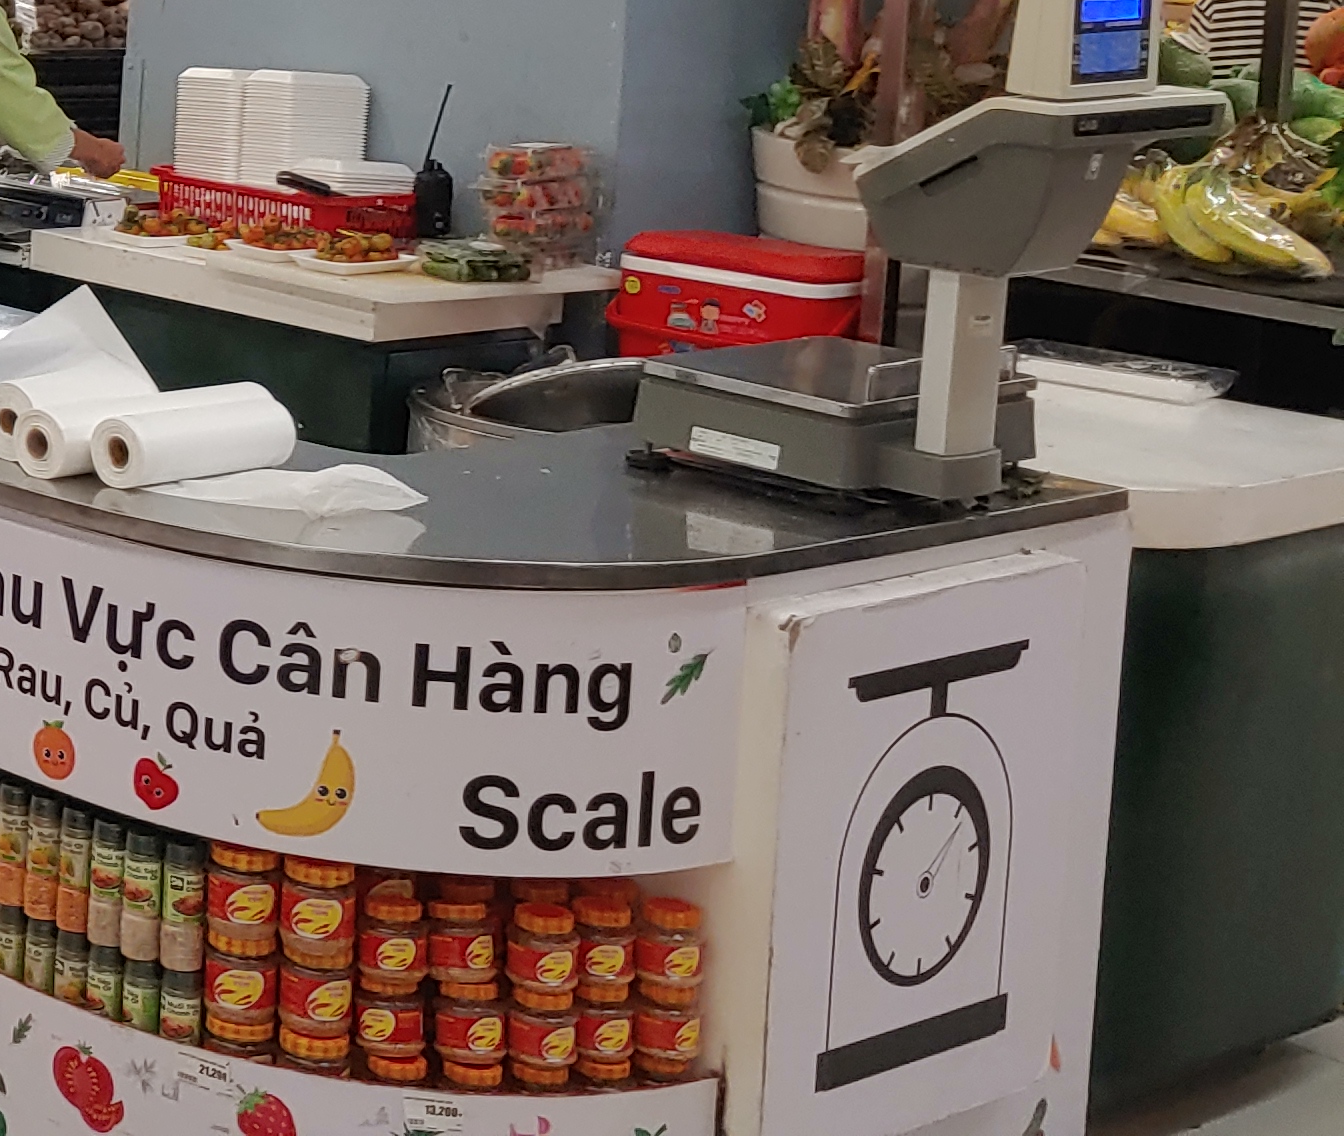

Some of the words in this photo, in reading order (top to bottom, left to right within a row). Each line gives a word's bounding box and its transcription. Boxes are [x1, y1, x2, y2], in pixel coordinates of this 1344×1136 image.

[60, 574, 197, 674] Vực
[217, 619, 383, 705] Cân
[411, 641, 635, 732] Hàng
[84, 675, 151, 742] Củ,
[164, 698, 267, 762] Quả
[458, 771, 702, 851] Scale
